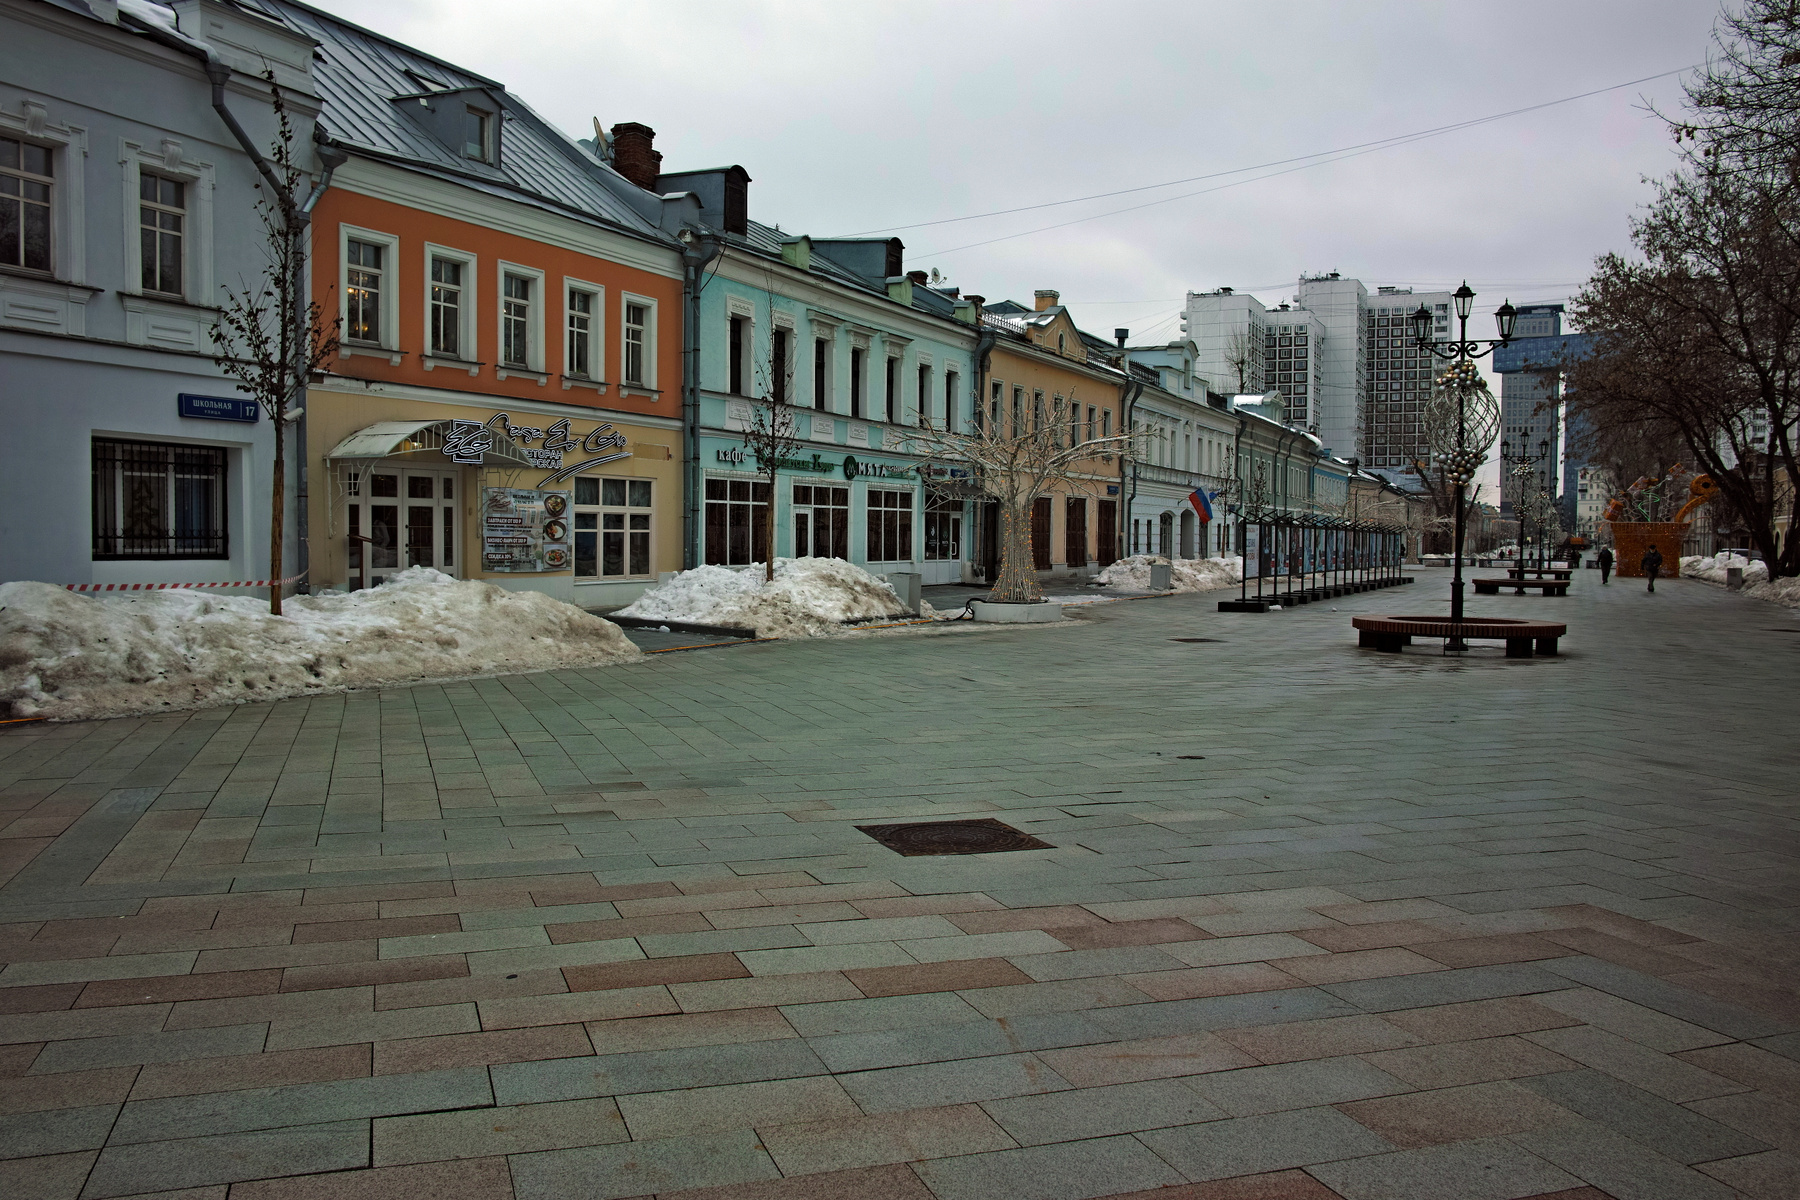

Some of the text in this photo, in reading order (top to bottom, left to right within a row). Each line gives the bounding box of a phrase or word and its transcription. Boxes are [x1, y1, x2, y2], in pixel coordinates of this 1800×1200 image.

[192, 399, 232, 410] ШКОЛЬНАЯ
[245, 405, 256, 417] 17
[717, 447, 747, 466] кафе
[857, 462, 887, 477] МЯТА
